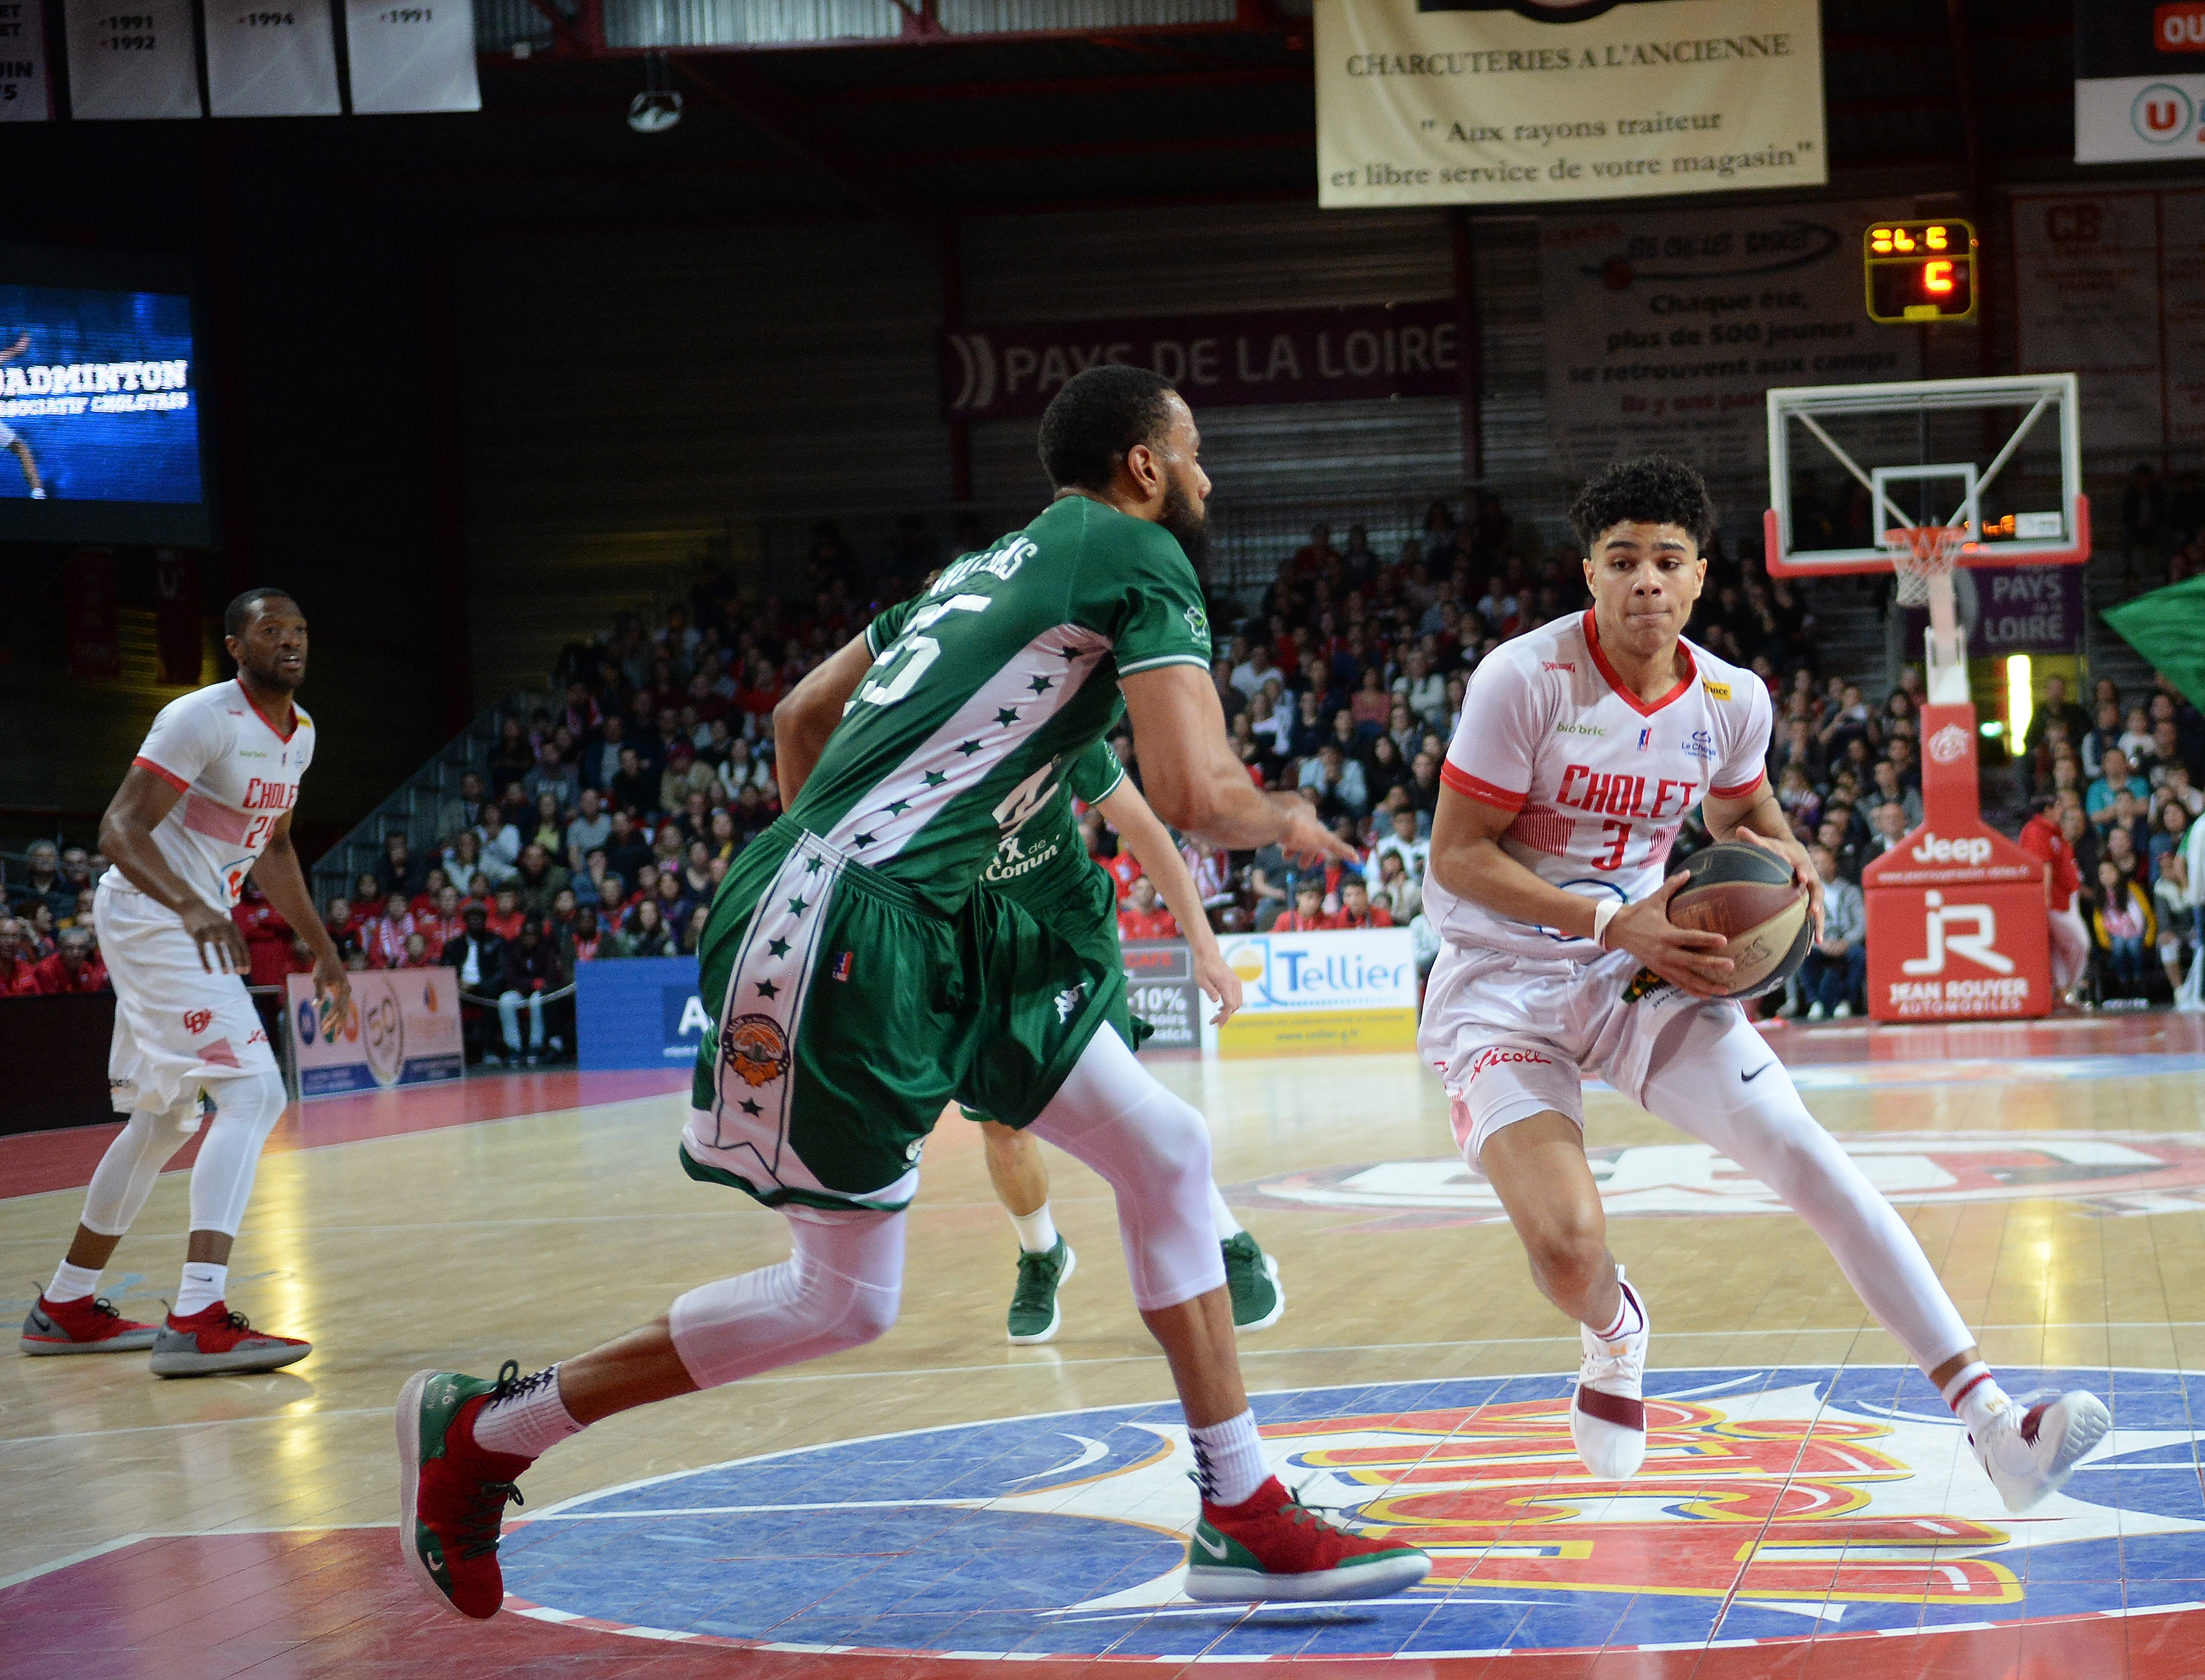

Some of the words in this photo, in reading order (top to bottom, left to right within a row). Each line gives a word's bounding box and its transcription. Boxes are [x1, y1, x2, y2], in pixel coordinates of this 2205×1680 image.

[1346, 49, 1570, 77] CHARCUTERIES
[1579, 47, 1597, 68] A
[1605, 33, 1791, 67] L'ANCIENNE
[1447, 122, 1505, 143] Aux
[1515, 121, 1607, 146] rayons
[1618, 111, 1722, 135] traiteur
[2147, 101, 2176, 131] U
[1331, 172, 1357, 188] et
[1366, 162, 1429, 186] libre
[1439, 164, 1538, 183] service
[1549, 160, 1583, 180] de
[1595, 158, 1661, 176] votre
[1673, 142, 1813, 179] magasin"
[1151, 338, 1219, 385] DE
[1236, 334, 1300, 383] LA
[1315, 323, 1459, 378] LOIRE
[1607, 332, 1661, 353] plus
[1670, 331, 1702, 346] de
[0, 359, 188, 398] ADMINTON
[1992, 574, 2063, 604] PAYS
[1984, 614, 2063, 644] LOIRE
[1555, 764, 1697, 819] CHOLET
[1591, 819, 1633, 871] 3
[1913, 834, 1993, 863] Jeep
[1275, 951, 1408, 992] Tellier
[1127, 987, 1187, 1012] -10%
[1889, 982, 1941, 1004] JEAN
[1944, 976, 2028, 1000] ROUYER
[1898, 996, 2023, 1015] AUTOMOBILES
